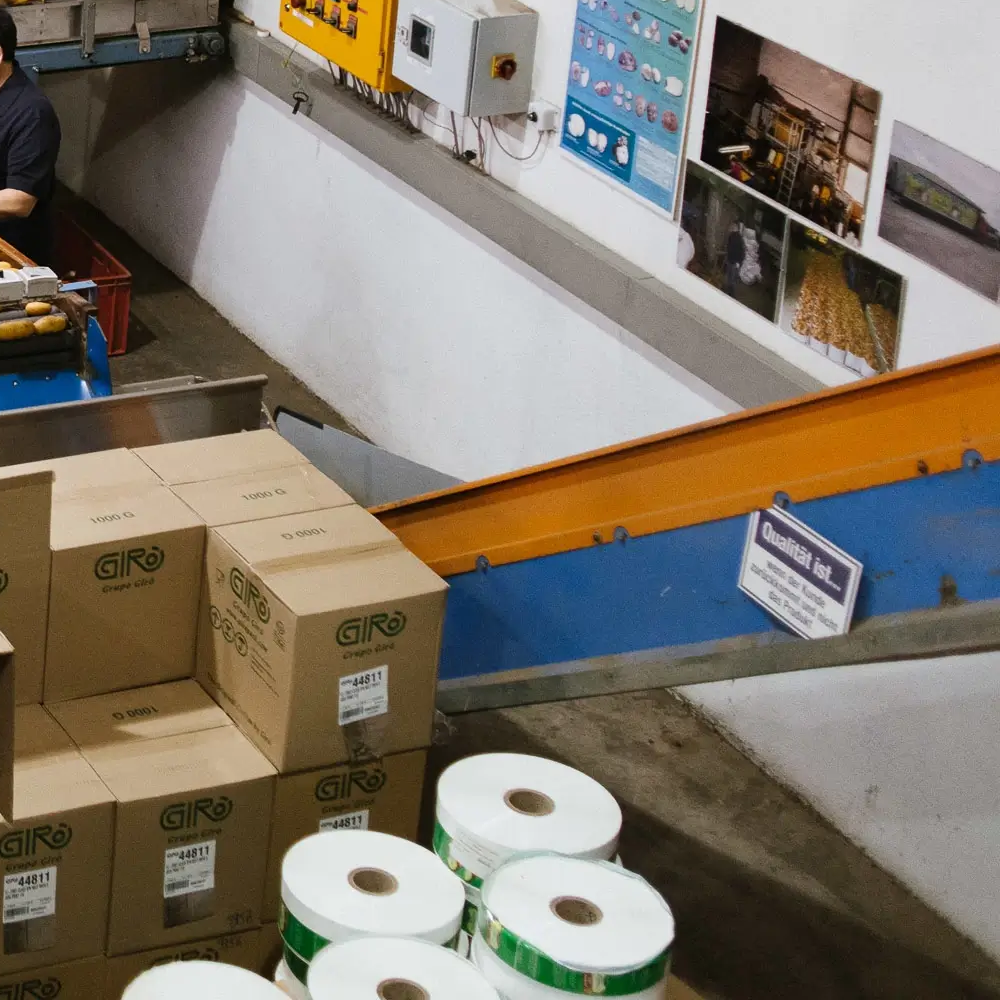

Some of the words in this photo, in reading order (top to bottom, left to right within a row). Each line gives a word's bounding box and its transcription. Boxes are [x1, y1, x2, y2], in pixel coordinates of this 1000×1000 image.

[240, 490, 273, 501] 1000
[274, 488, 288, 496] G
[89, 513, 121, 525] 1000
[122, 511, 136, 519] G
[295, 527, 328, 538] 1000
[761, 521, 812, 570] Qualität
[101, 582, 132, 594] Grupo
[352, 671, 382, 687] 44811
[112, 711, 125, 720] G
[126, 706, 160, 718] 1000
[332, 815, 363, 830] 44811
[178, 846, 210, 861] 44811
[18, 872, 50, 887] 44811
